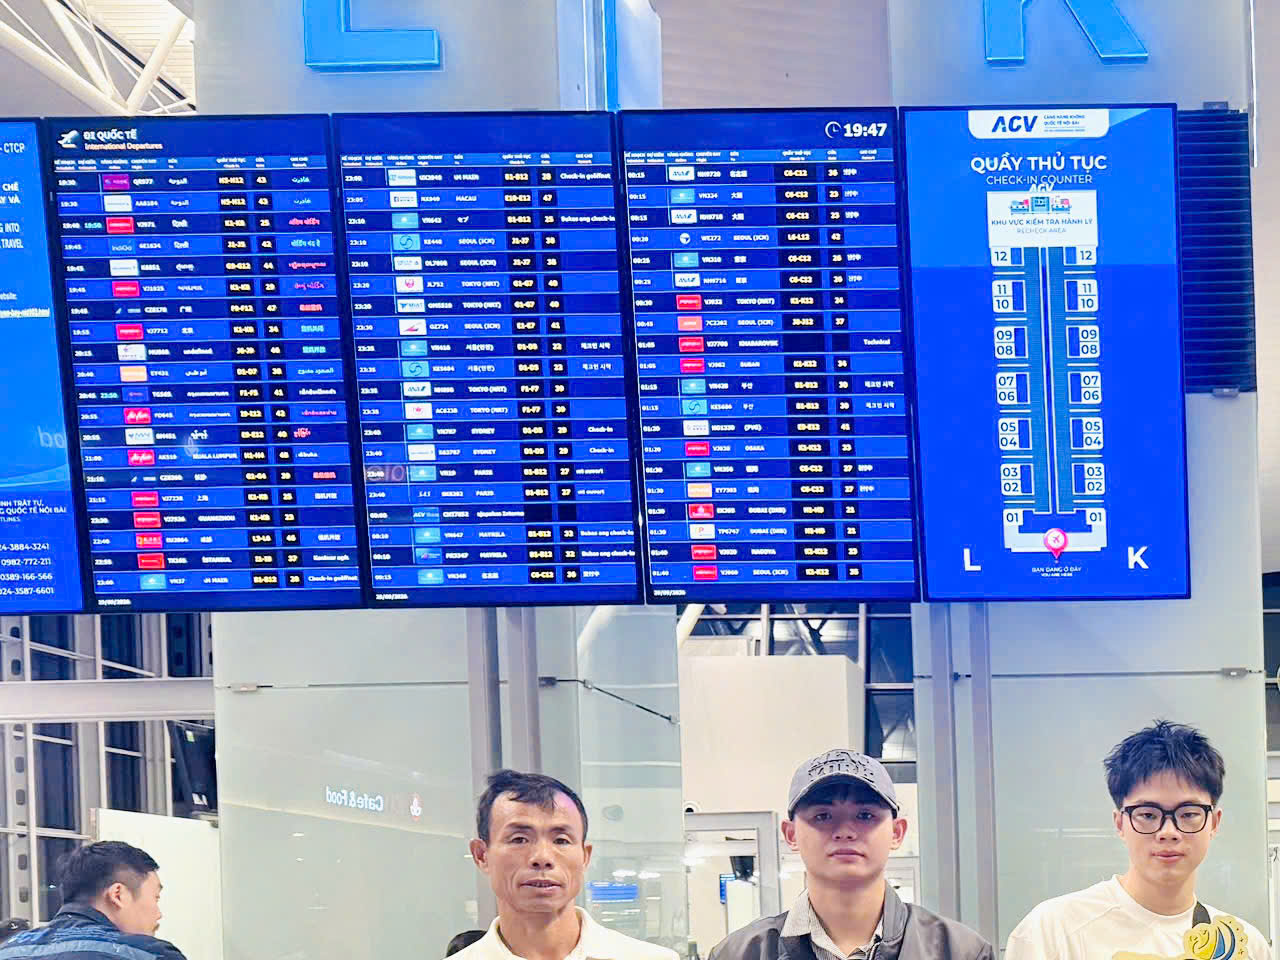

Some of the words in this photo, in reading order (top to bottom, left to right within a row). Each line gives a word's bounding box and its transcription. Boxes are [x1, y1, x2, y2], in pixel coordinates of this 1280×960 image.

[992, 116, 1038, 132] ACV
[83, 131, 95, 140] ĐI
[96, 128, 124, 141] QUỐC
[843, 123, 888, 137] 19:47
[4, 142, 25, 153] CTCP
[970, 152, 1022, 174] QUẦY
[1027, 151, 1065, 170] THỦ
[1070, 156, 1107, 174] TỤC
[986, 175, 1038, 184] CHECK-IN
[1040, 174, 1092, 184] COUNTER
[2, 182, 18, 191] CHẾ
[8, 194, 20, 204] VÀ
[6, 223, 20, 232] INTO
[2, 238, 23, 248] TRAVEL
[994, 252, 1008, 262] 12
[1080, 250, 1092, 261] 12
[997, 284, 1006, 294] 11
[1082, 284, 1092, 294] 11
[996, 300, 1010, 310] 10
[1082, 298, 1094, 308] 10
[996, 330, 1012, 340] 09
[1081, 329, 1097, 339] 09
[996, 346, 1013, 356] 08
[1082, 344, 1098, 355] 08
[998, 376, 1014, 386] 07
[1082, 376, 1098, 386] 07
[998, 392, 1015, 401] 06
[1083, 391, 1100, 401] 06
[1000, 422, 1016, 432] 05
[1085, 422, 1100, 432] 05
[1000, 437, 1017, 447] 04
[1084, 436, 1102, 446] 04
[1002, 467, 1018, 477] 03
[1087, 466, 1102, 476] 03
[1004, 482, 1019, 492] 02
[1087, 482, 1103, 492] 02
[1006, 512, 1018, 523] 01
[1090, 512, 1102, 522] 01
[964, 548, 982, 571] L
[1128, 546, 1149, 569] K
